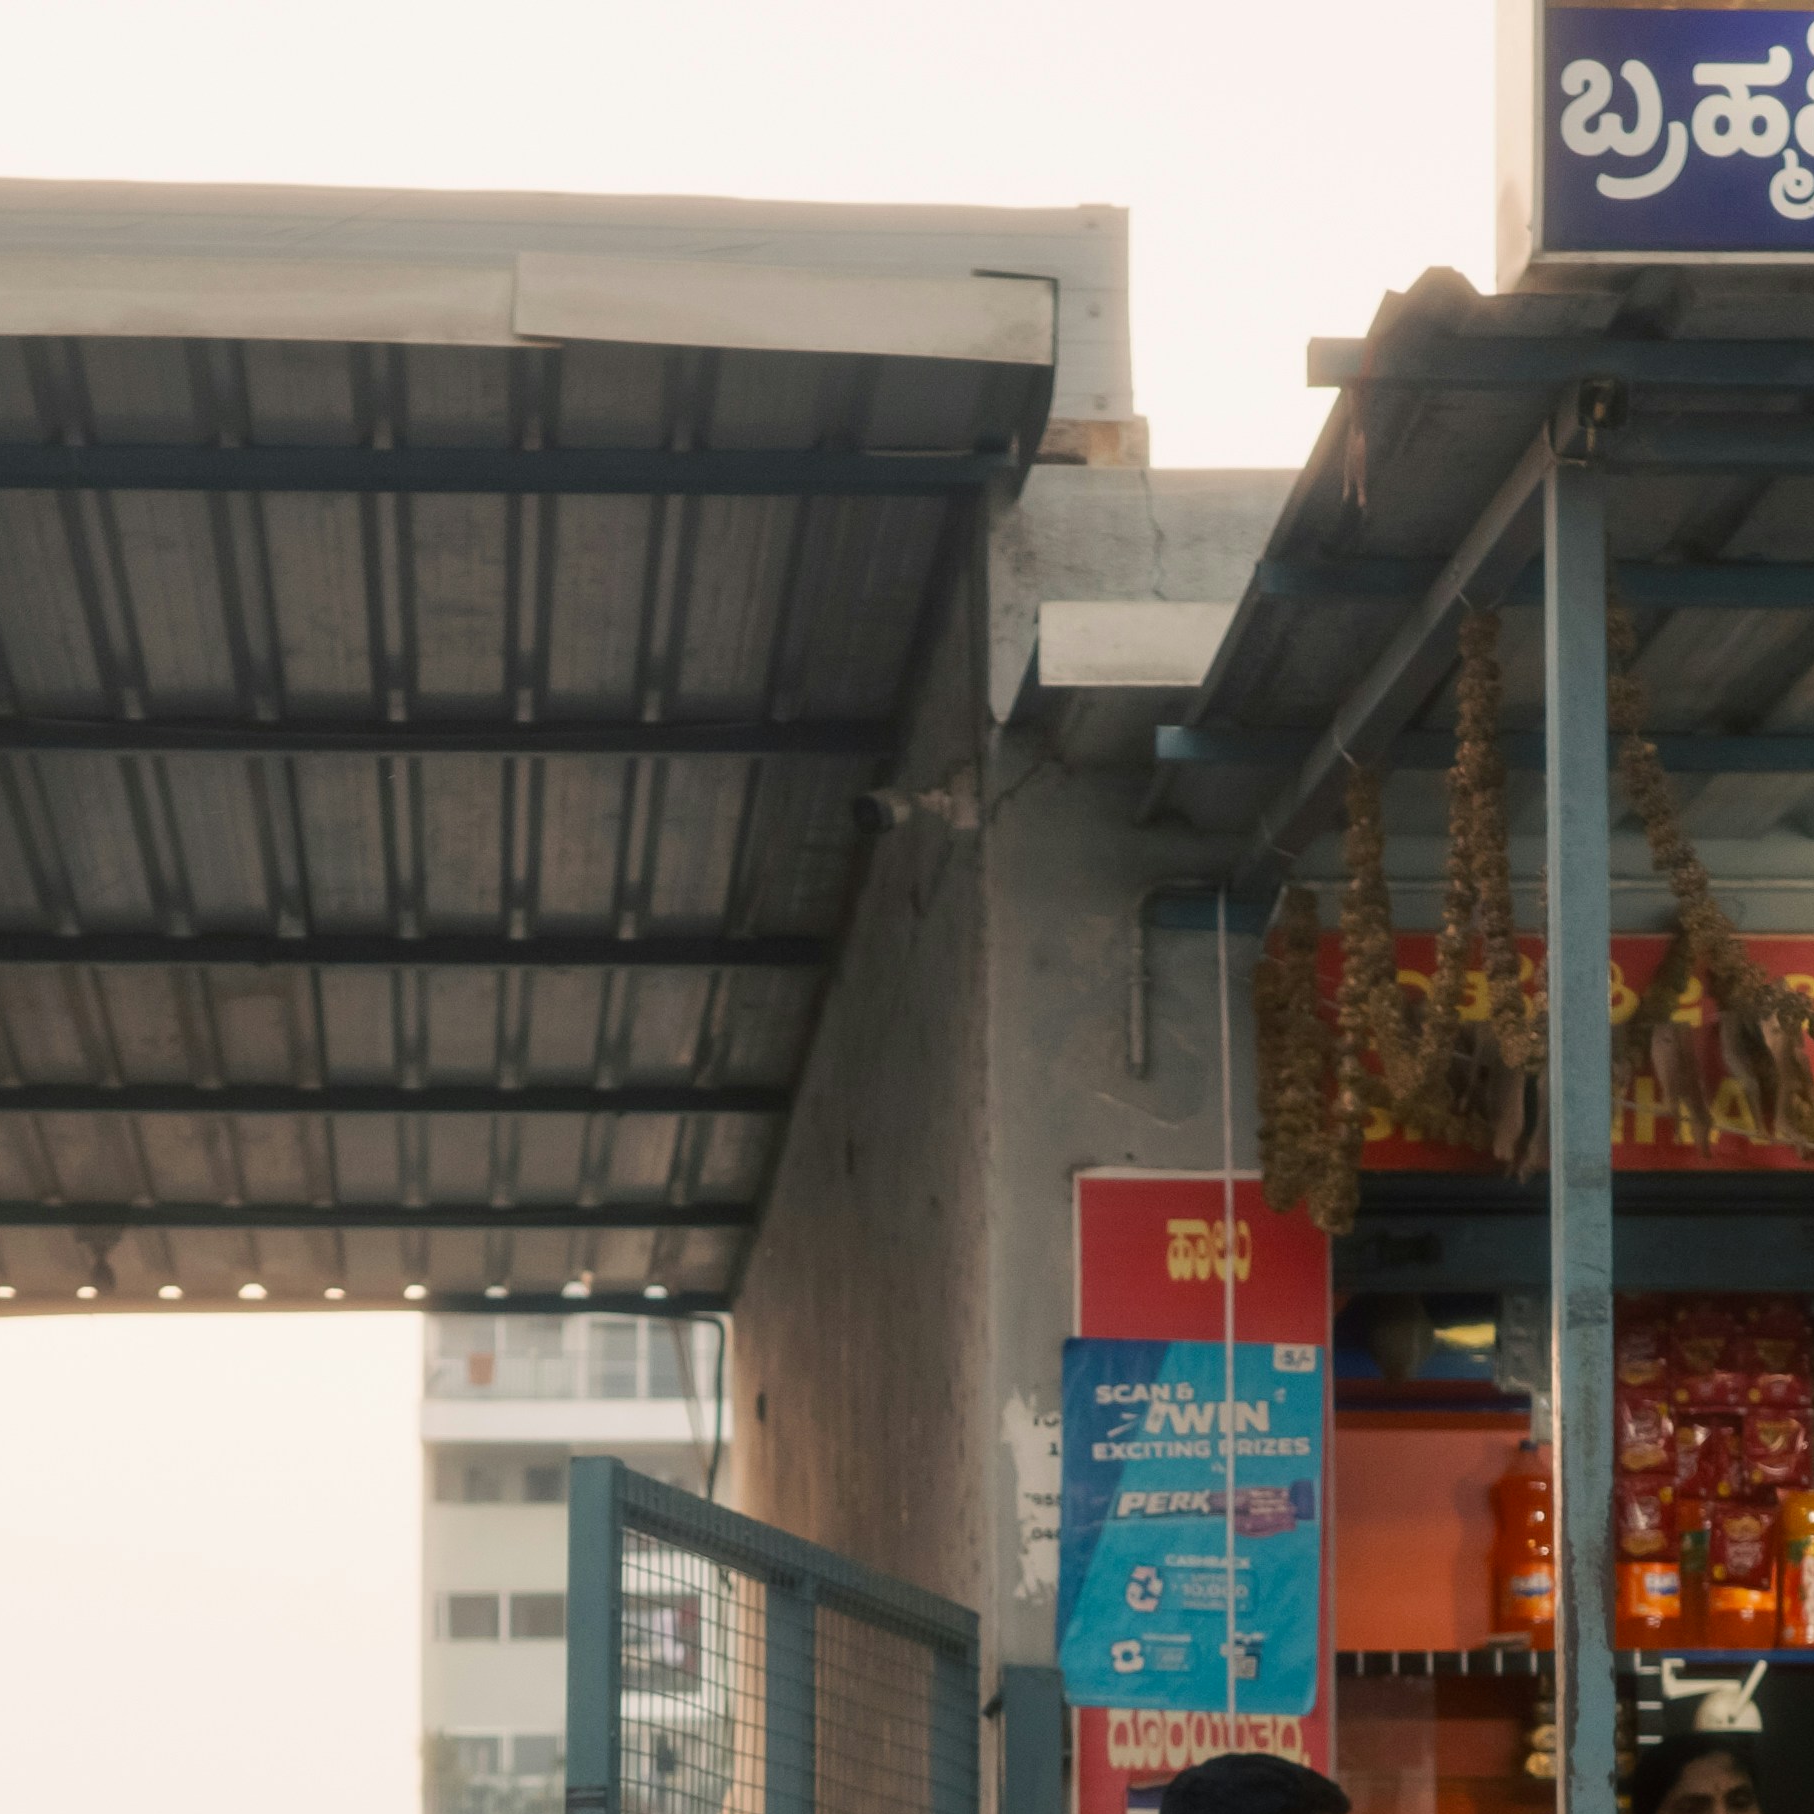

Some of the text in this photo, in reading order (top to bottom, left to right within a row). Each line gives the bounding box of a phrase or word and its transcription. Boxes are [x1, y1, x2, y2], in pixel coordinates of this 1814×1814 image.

[1095, 1383, 1171, 1405] SCAN
[1091, 1439, 1212, 1462] EXCITING
[1116, 1490, 1211, 1518] PERK
